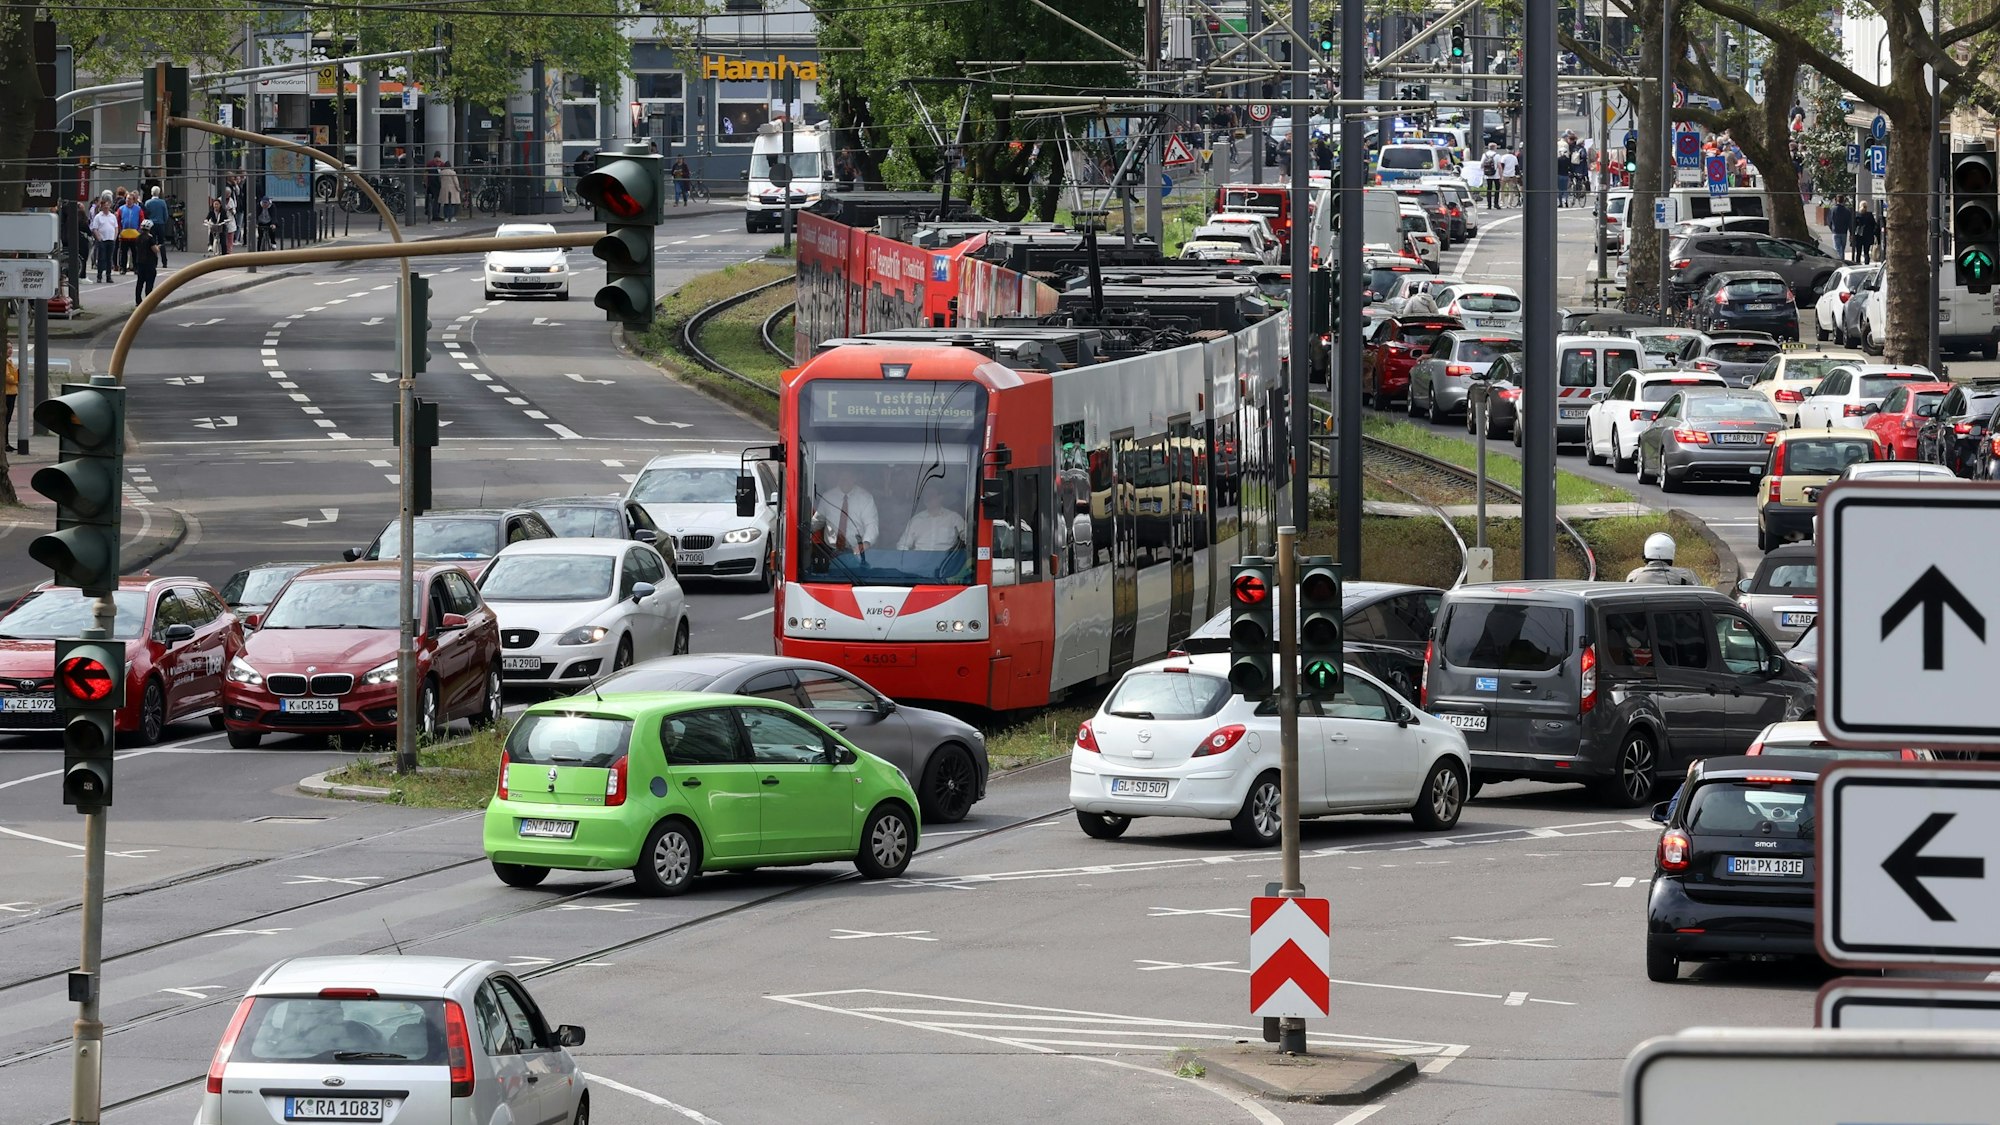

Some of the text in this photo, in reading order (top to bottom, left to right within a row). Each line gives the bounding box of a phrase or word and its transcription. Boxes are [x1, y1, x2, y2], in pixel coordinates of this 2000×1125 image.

[1254, 105, 1266, 115] 30
[1848, 146, 1856, 160] P
[1678, 156, 1698, 165] TAXI
[1874, 150, 1883, 171] P
[1710, 184, 1727, 193] TAXI
[828, 391, 947, 418] E Testfahrt
[847, 406, 973, 418] Bitte nicht einsteigen
[866, 607, 883, 615] KVB
[1787, 614, 1812, 624] K AB
[520, 659, 539, 668] 2900
[864, 653, 897, 664] 4503
[4, 700, 54, 709] K ZE 1972
[289, 700, 334, 710] K CR 156
[1463, 717, 1485, 728] 2146
[1118, 780, 1167, 793] GL SD 507
[526, 820, 572, 833] BN AD 700
[1735, 859, 1802, 873] BM PX 181E
[295, 1100, 305, 1115] K
[316, 1100, 336, 1116] RA
[339, 1100, 379, 1116] 1083
